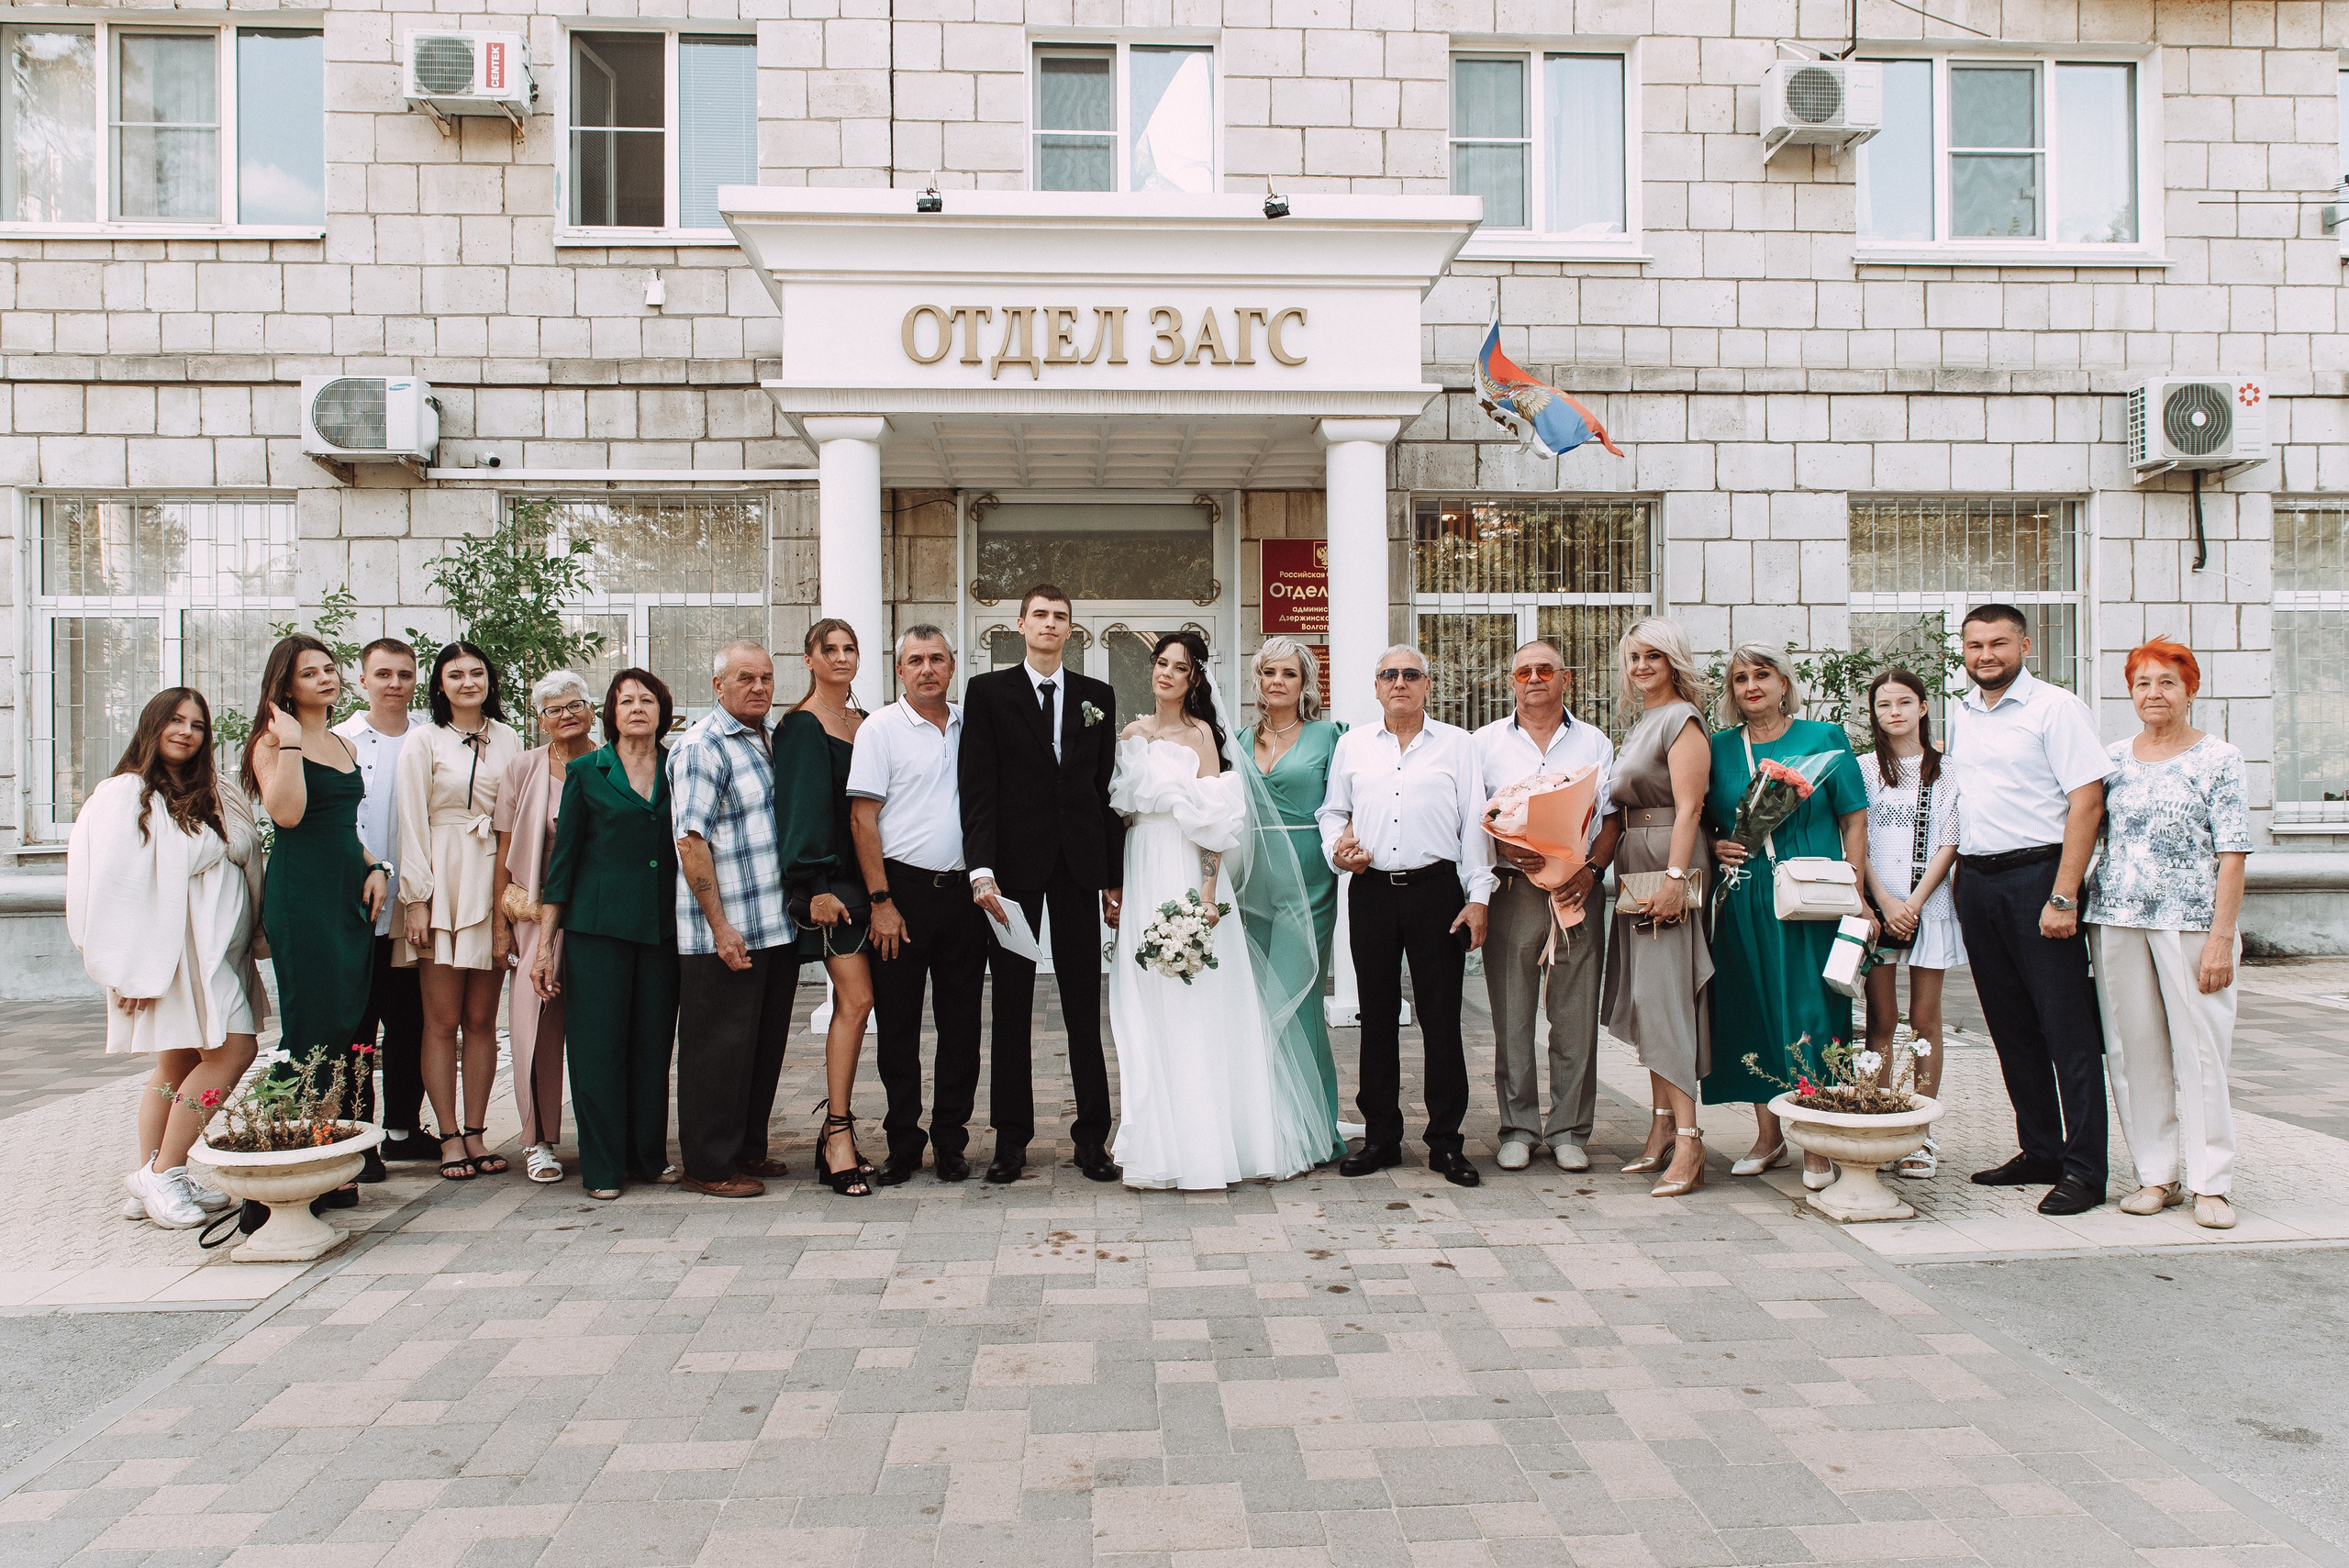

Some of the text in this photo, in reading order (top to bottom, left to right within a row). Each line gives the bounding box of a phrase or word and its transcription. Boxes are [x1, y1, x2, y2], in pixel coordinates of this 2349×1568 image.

[491, 45, 500, 88] CENTEK
[900, 304, 1308, 381] ОТДЕЛ ЗАГС
[1269, 582, 1329, 600] Отдел
